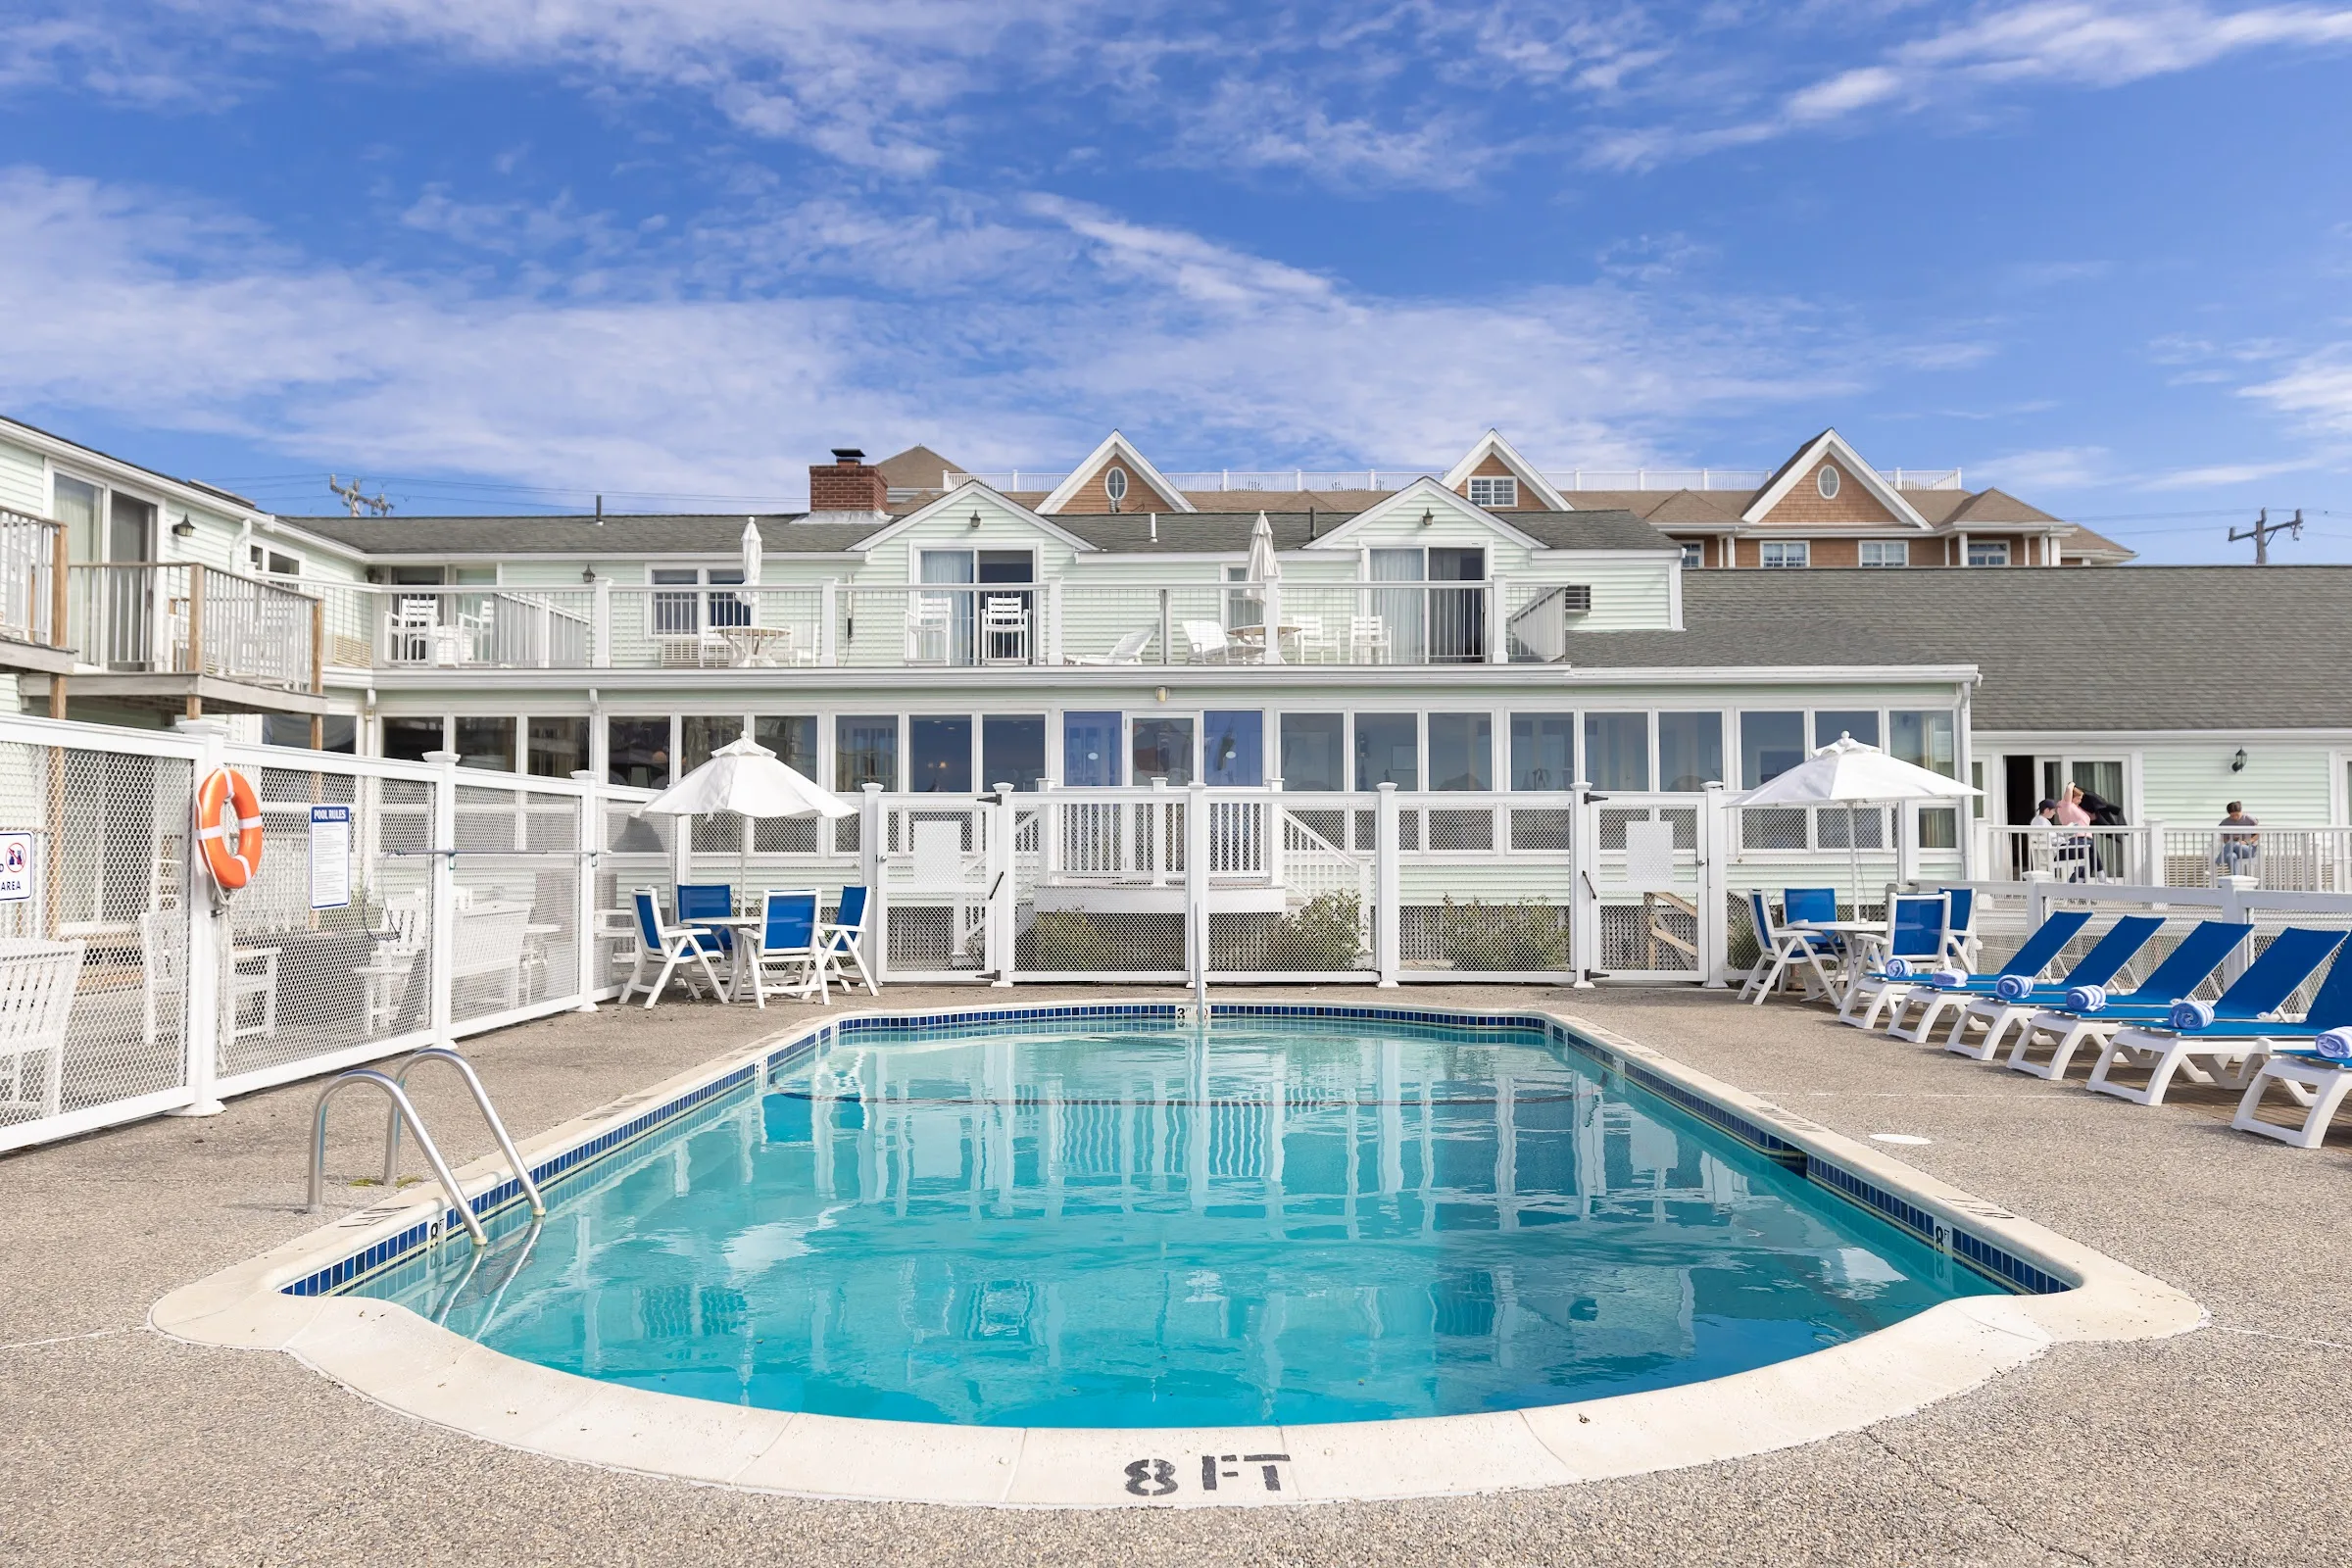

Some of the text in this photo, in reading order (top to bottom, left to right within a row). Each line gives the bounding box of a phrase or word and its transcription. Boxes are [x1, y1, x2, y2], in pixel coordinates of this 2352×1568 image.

[314, 808, 347, 820] POOL RULES
[1, 881, 21, 891] AREA
[1177, 1007, 1186, 1020] 3
[1936, 1225, 1944, 1253] 8
[1124, 1454, 1292, 1496] 8 FT
